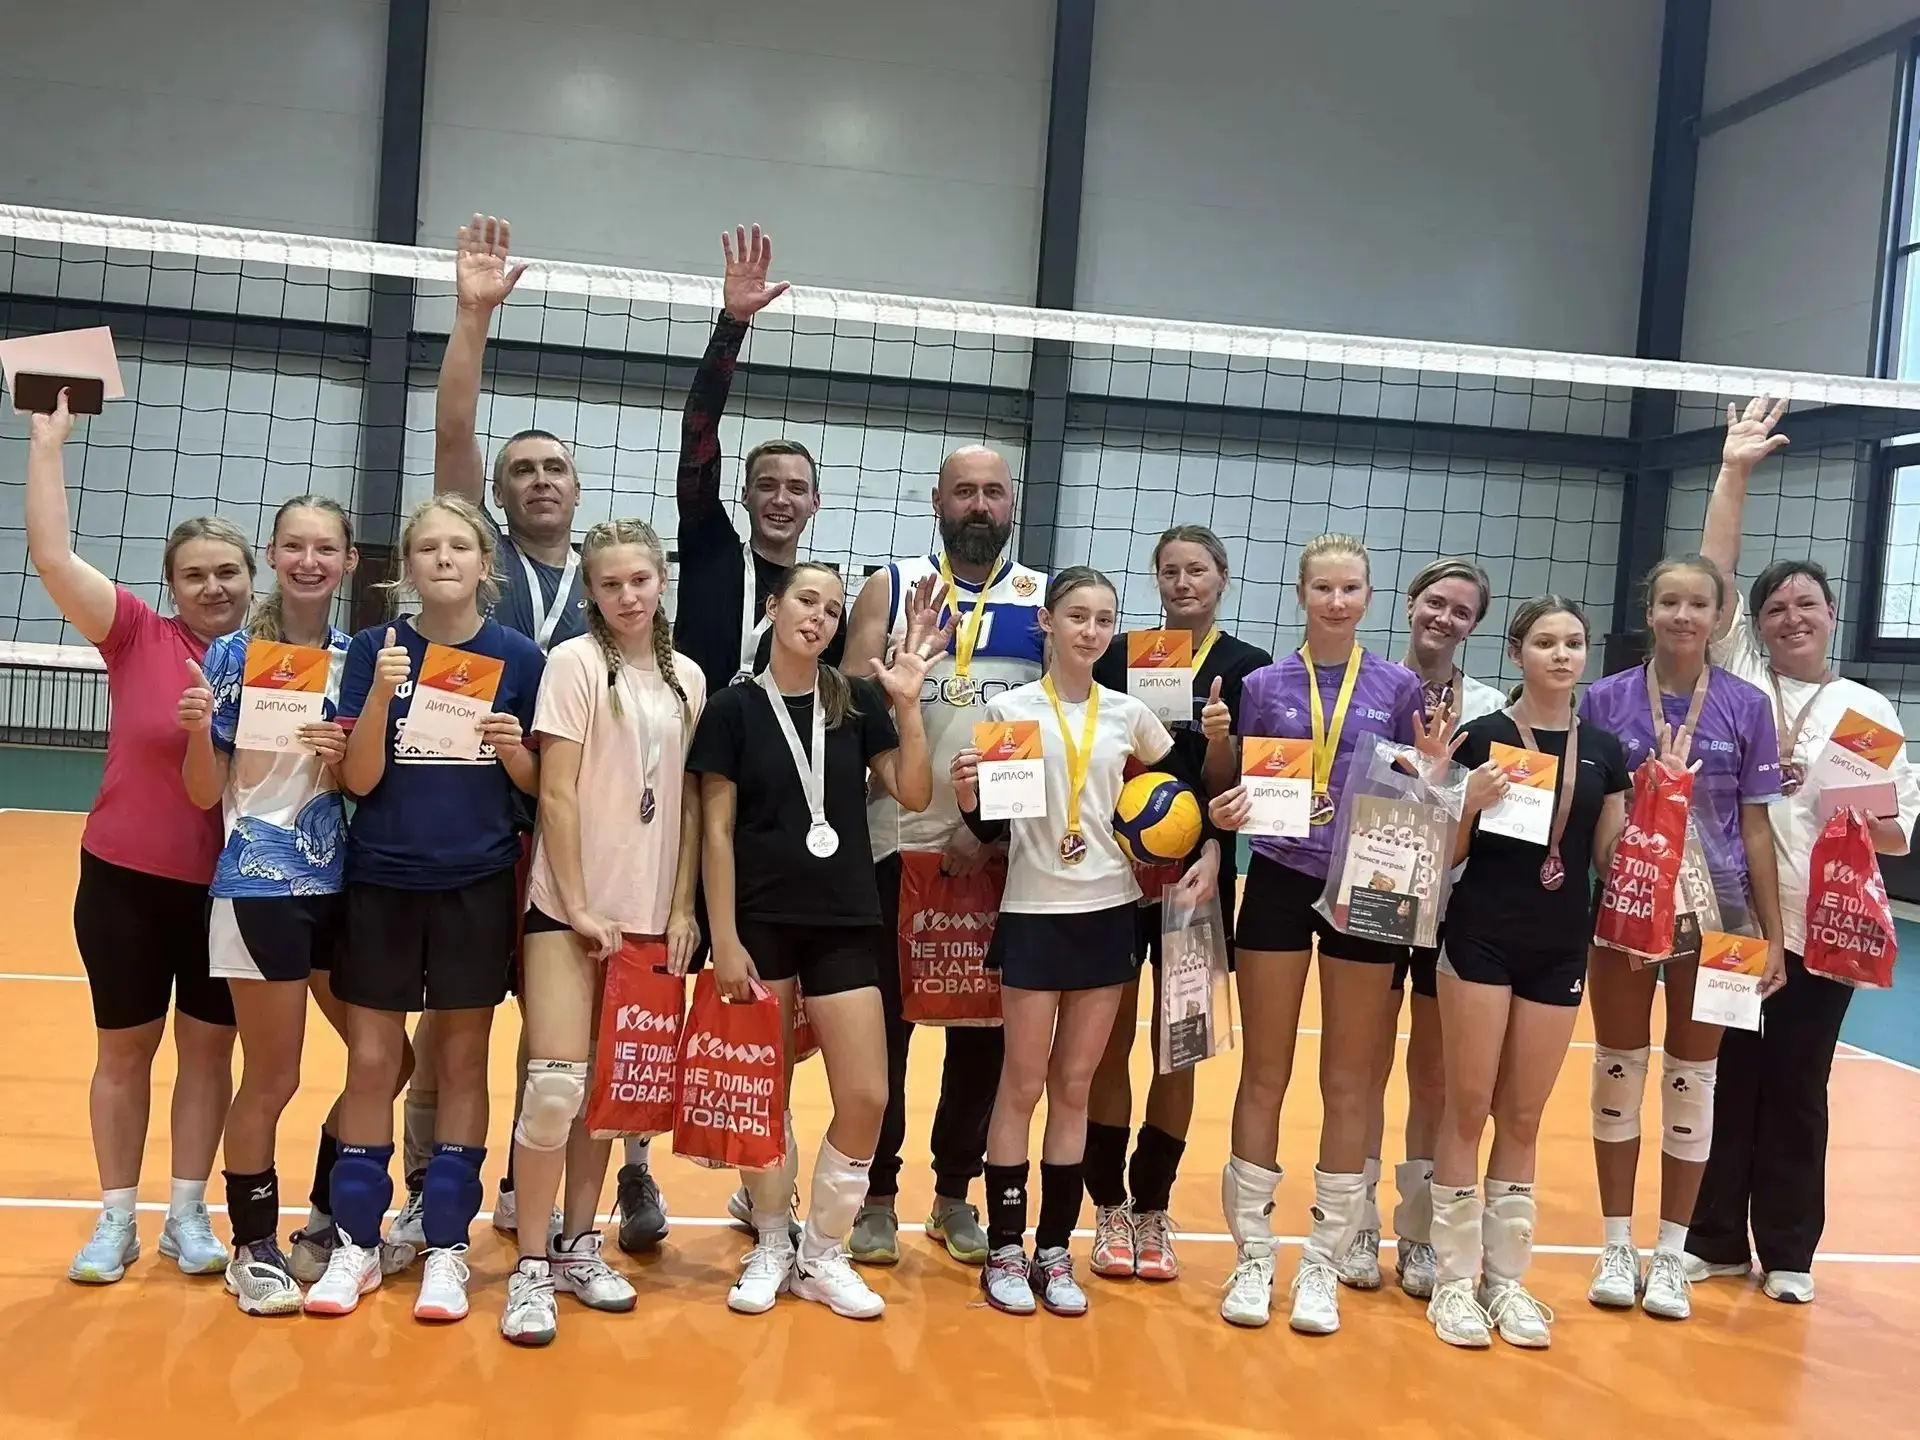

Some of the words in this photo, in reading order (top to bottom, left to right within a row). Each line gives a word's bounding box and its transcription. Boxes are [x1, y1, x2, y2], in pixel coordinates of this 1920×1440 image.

[1139, 678, 1181, 688] ДИПЛОМ
[255, 700, 307, 714] ДИПЛОМ
[425, 700, 476, 719] ДИПЛОМ
[990, 771, 1034, 783] ДИПЛОМ
[1830, 754, 1871, 780] ДИПЛОМ
[1253, 787, 1299, 799] ДИПЛОМ
[1503, 793, 1541, 807] ИПЛОМ
[1611, 872, 1655, 897] КАН
[911, 942, 937, 958] НЕ
[941, 941, 989, 958] ТОЛЬ
[1811, 924, 1887, 958] ТОВАРЫ
[1708, 978, 1751, 993] ДИПЛОМ
[616, 1004, 680, 1034] Ком
[614, 1041, 637, 1060] НЕ
[641, 1044, 677, 1064] ТОЛЬ
[684, 1068, 710, 1086] НЕ
[714, 1071, 774, 1096] ТОЛЬКО
[700, 1090, 770, 1116] КАНЦ
[683, 1106, 771, 1137] ТОВАРЫ
